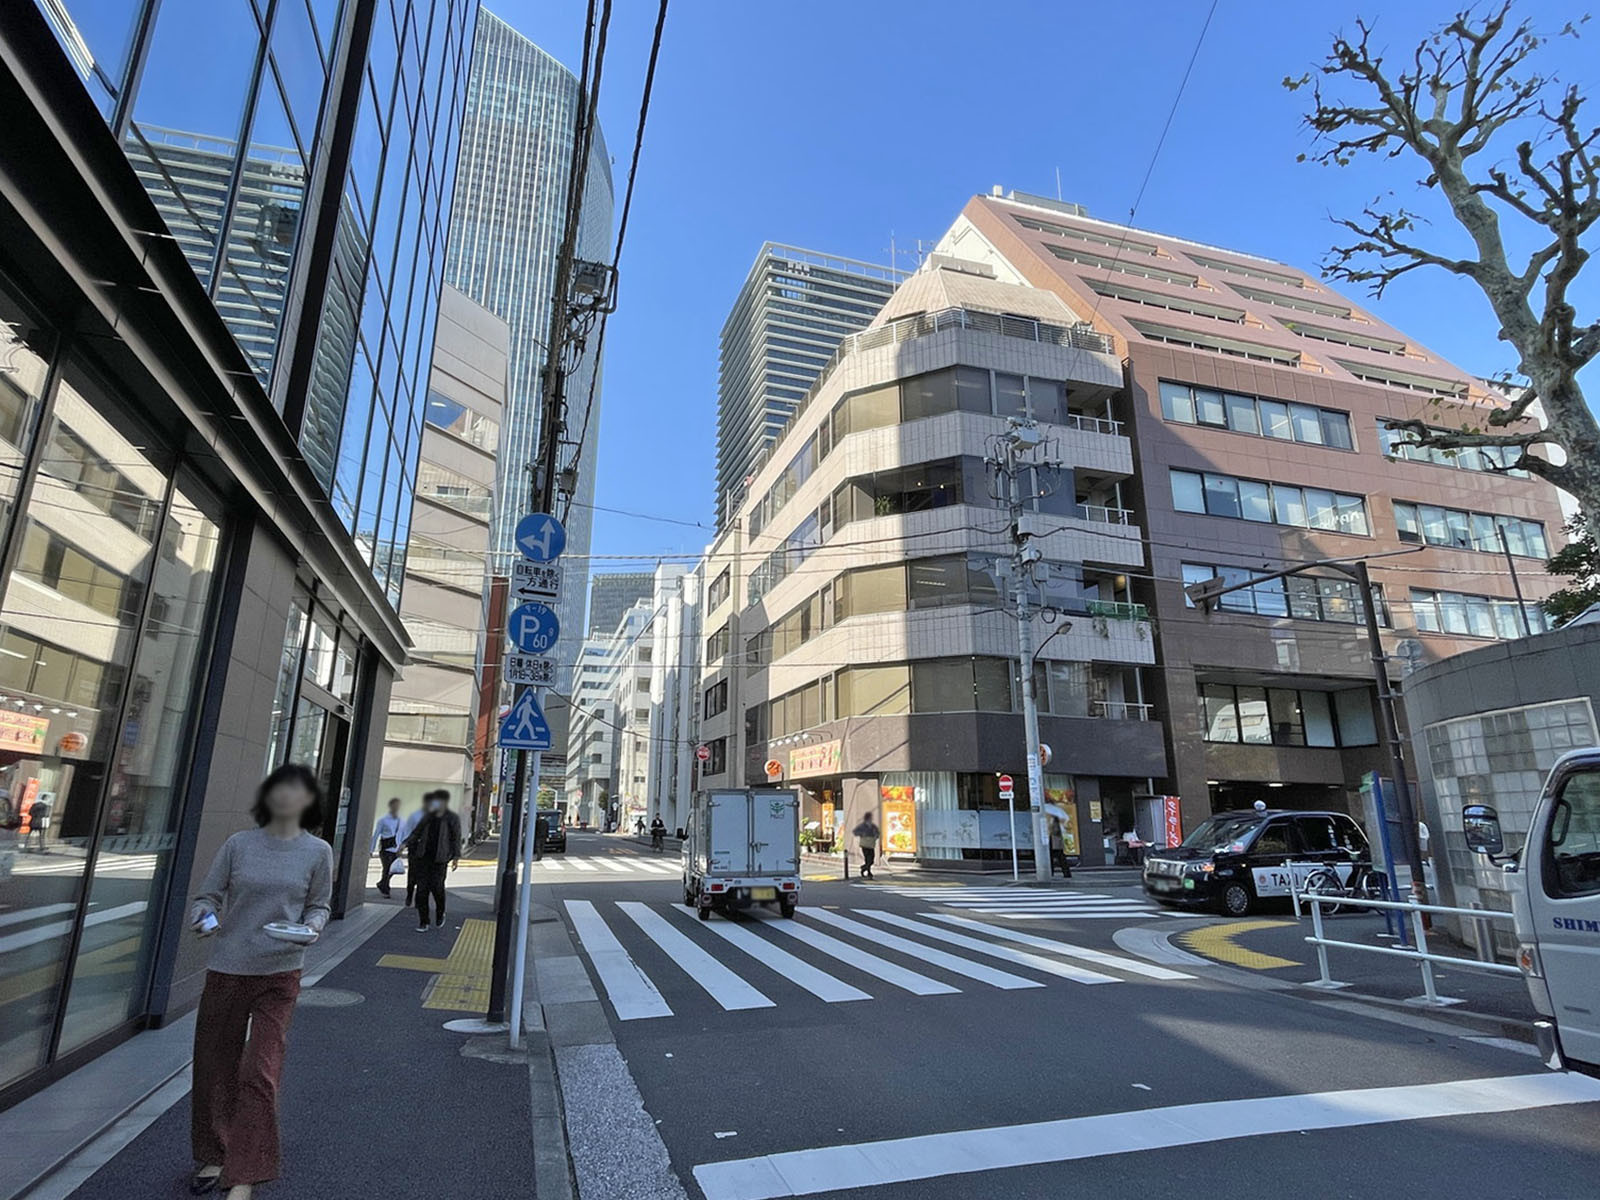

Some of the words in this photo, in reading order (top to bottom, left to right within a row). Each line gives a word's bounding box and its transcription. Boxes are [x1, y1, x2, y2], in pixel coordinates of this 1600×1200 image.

[516, 576, 559, 590] 一方通行
[520, 615, 540, 647] P
[533, 634, 548, 649] 60
